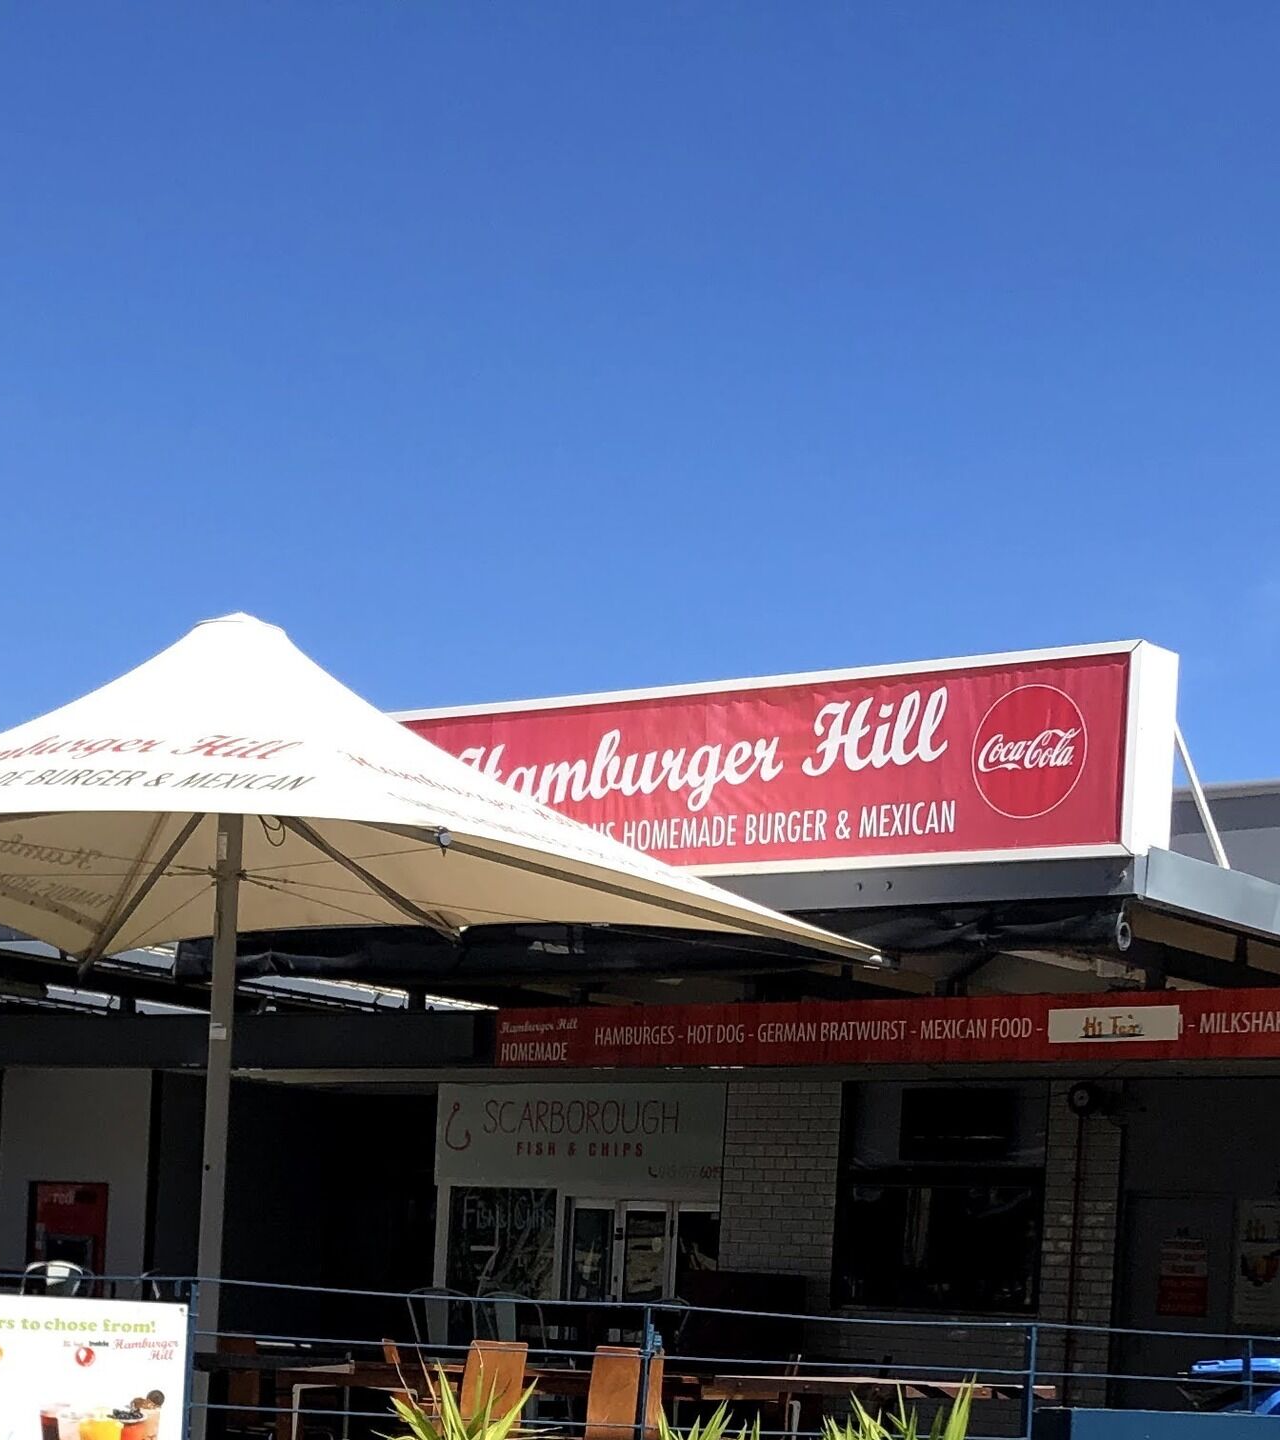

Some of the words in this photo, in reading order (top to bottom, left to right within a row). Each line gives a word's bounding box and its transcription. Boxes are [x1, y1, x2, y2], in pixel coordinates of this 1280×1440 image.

[171, 734, 304, 761] Hill
[455, 729, 784, 812] Hamburger
[802, 686, 949, 777] Hill
[24, 768, 138, 787] BURGER
[143, 772, 175, 788] &
[171, 771, 318, 792] MEXICAN
[623, 814, 738, 850] HOMEMADE
[744, 808, 828, 846] BURGER
[834, 808, 851, 839] &
[858, 800, 957, 837] MEXICAN
[687, 1025, 713, 1044] HOT
[717, 1024, 745, 1043] DOG
[757, 1022, 817, 1043] GERMAN
[820, 1020, 907, 1041] BRATWURST
[920, 1019, 987, 1040] MEXICAN
[991, 1017, 1033, 1039] FOOD
[501, 1041, 569, 1062] HOMEMADE
[483, 1099, 680, 1135] SCARBOROUGH
[516, 1141, 556, 1156] FISH
[588, 1142, 644, 1157] CHIPS
[21, 1317, 41, 1331] to
[43, 1317, 98, 1333] chose
[102, 1318, 157, 1334] from!
[111, 1336, 180, 1351] Hamburger
[147, 1349, 174, 1361] Hill
